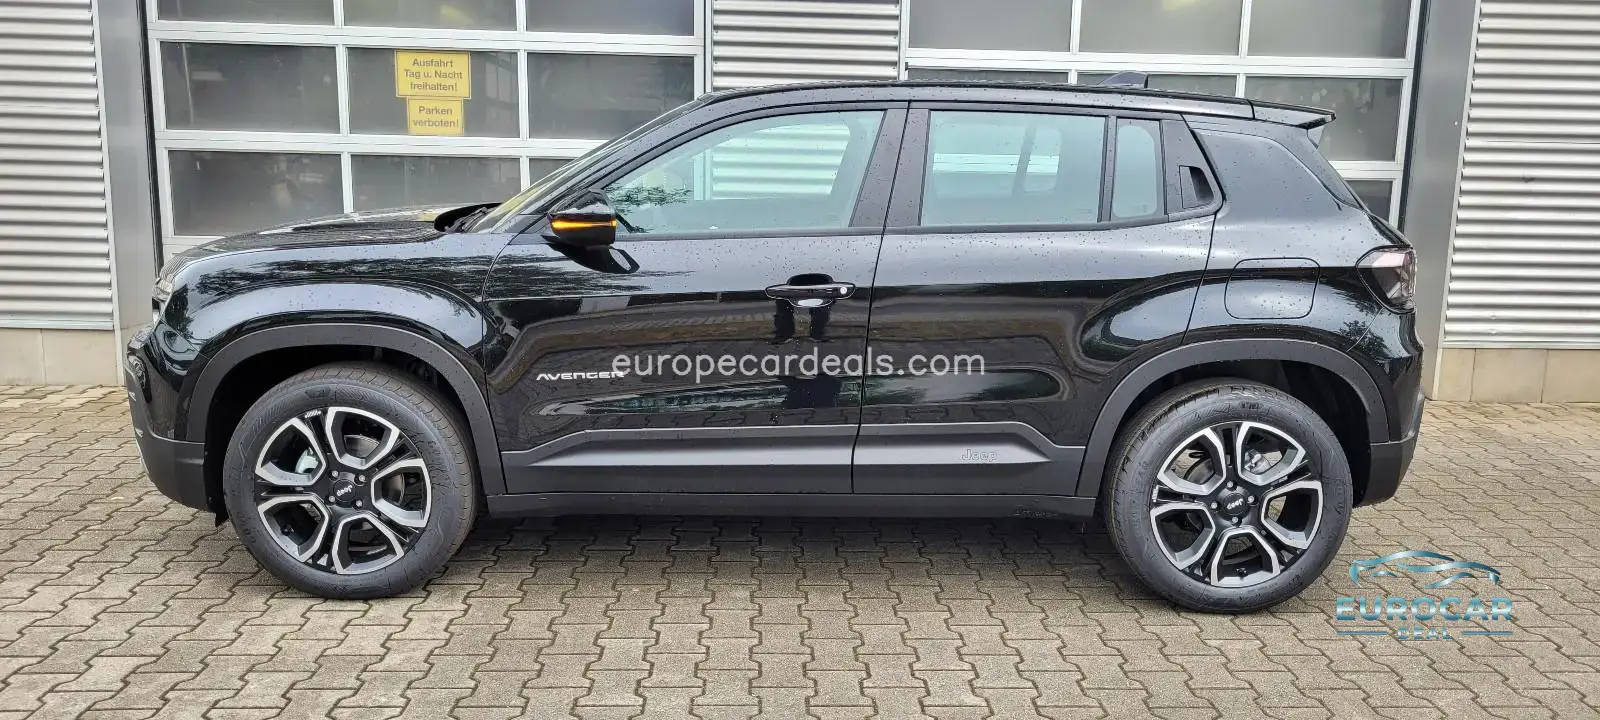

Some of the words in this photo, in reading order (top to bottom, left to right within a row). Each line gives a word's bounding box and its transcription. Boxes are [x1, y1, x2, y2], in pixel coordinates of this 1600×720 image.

[412, 58, 453, 68] Ausfahrt
[404, 69, 421, 79] Tag
[434, 70, 463, 79] Nacht
[418, 106, 453, 115] Parken
[413, 118, 459, 128] verboten!
[536, 371, 625, 380] AVENGER
